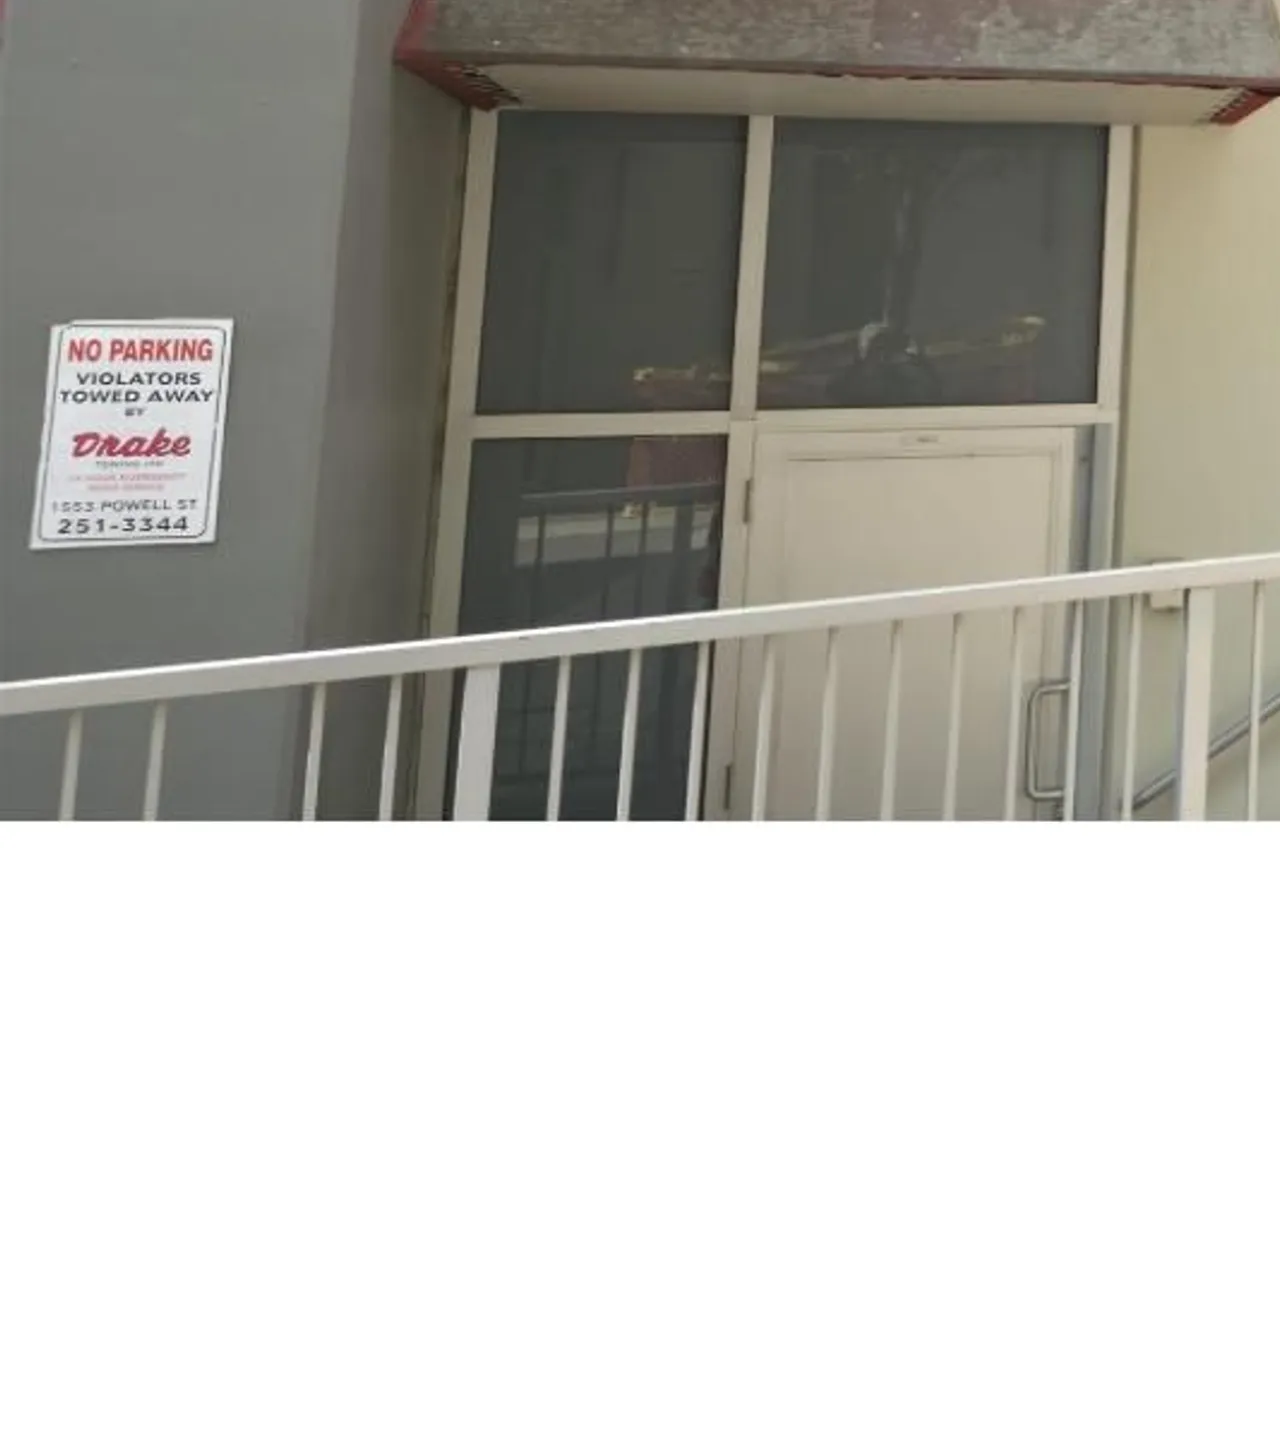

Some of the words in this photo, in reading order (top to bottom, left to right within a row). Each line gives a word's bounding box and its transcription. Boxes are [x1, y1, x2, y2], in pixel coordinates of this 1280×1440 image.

[67, 338, 101, 362] NO
[109, 338, 213, 362] PARKING
[76, 372, 201, 386] VIOLATORS
[59, 390, 140, 403] TOWED
[147, 390, 213, 403] AWAY
[71, 427, 192, 458] Drake
[101, 500, 172, 513] POWELL
[177, 499, 198, 510] ST
[57, 516, 188, 534] 251-3344
